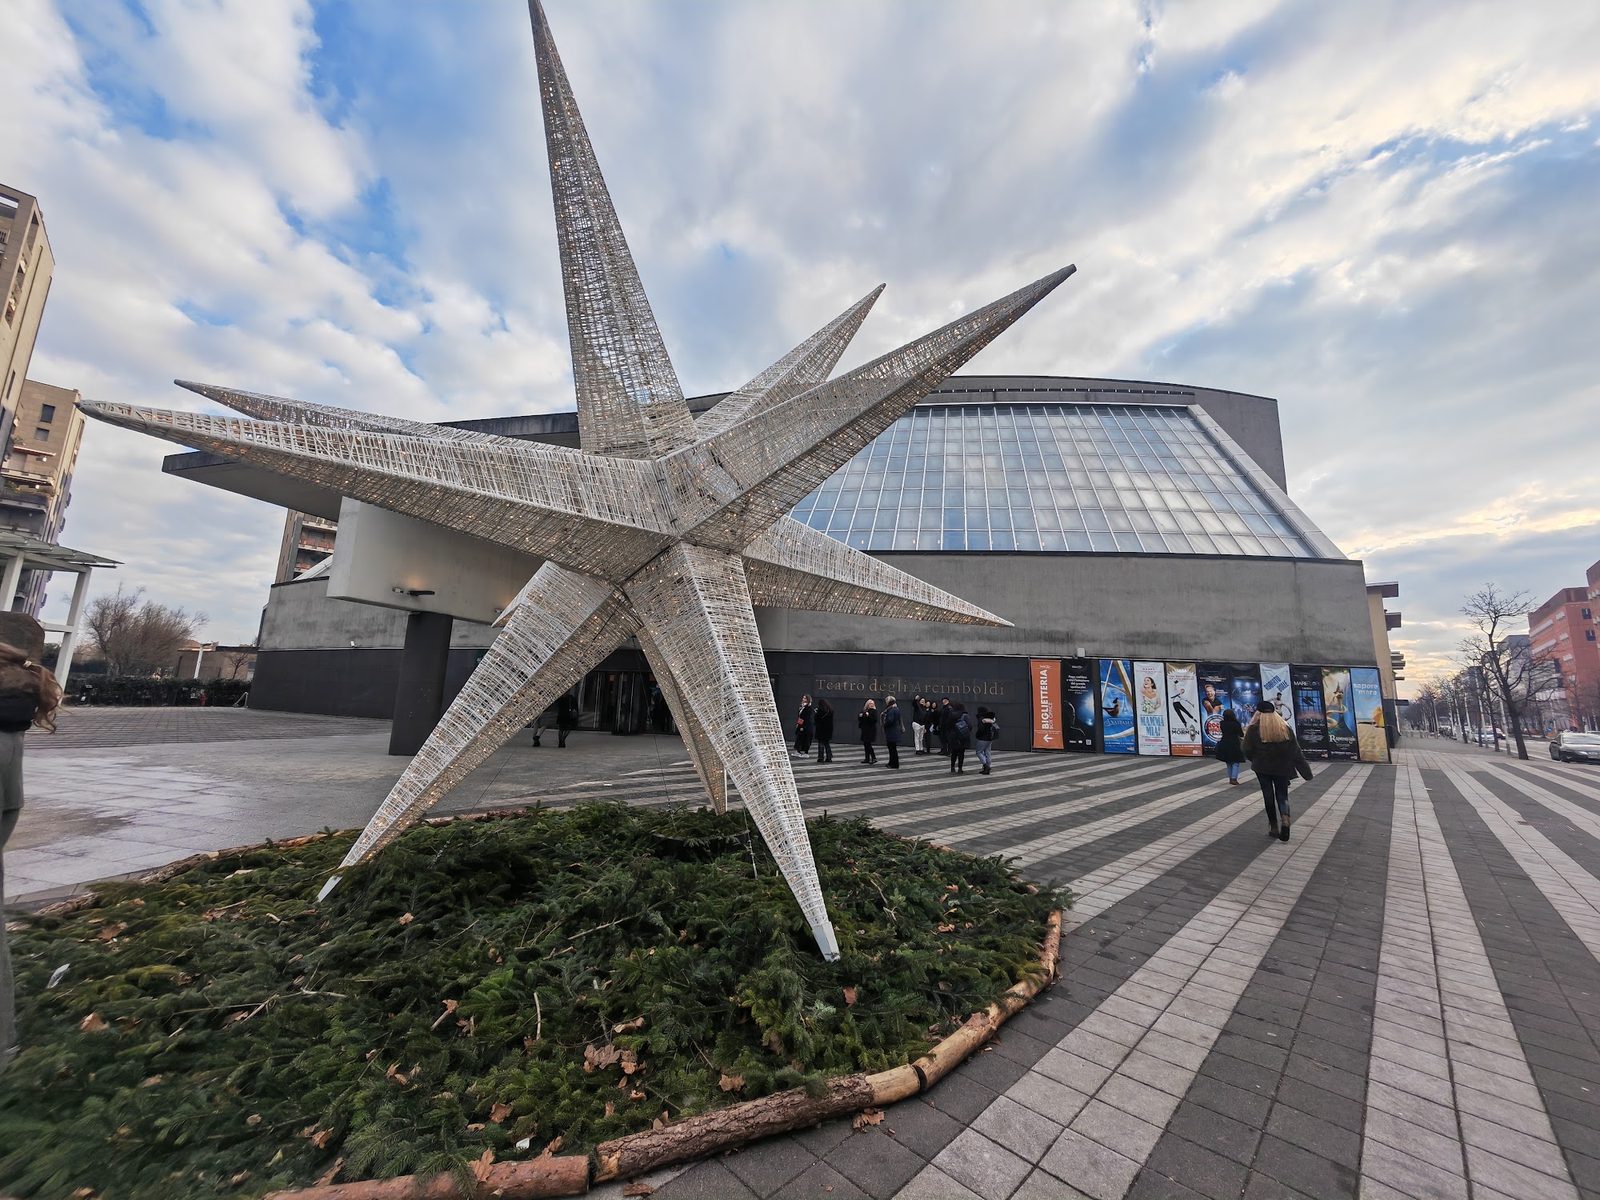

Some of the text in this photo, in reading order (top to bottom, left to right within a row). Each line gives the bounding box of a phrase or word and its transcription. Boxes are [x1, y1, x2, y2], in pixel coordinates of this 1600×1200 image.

[816, 678, 1005, 696] Teatro degli Arcimboldi
[1040, 669, 1050, 730] BIGLIETTERIA
[1140, 716, 1165, 727] MAMMA
